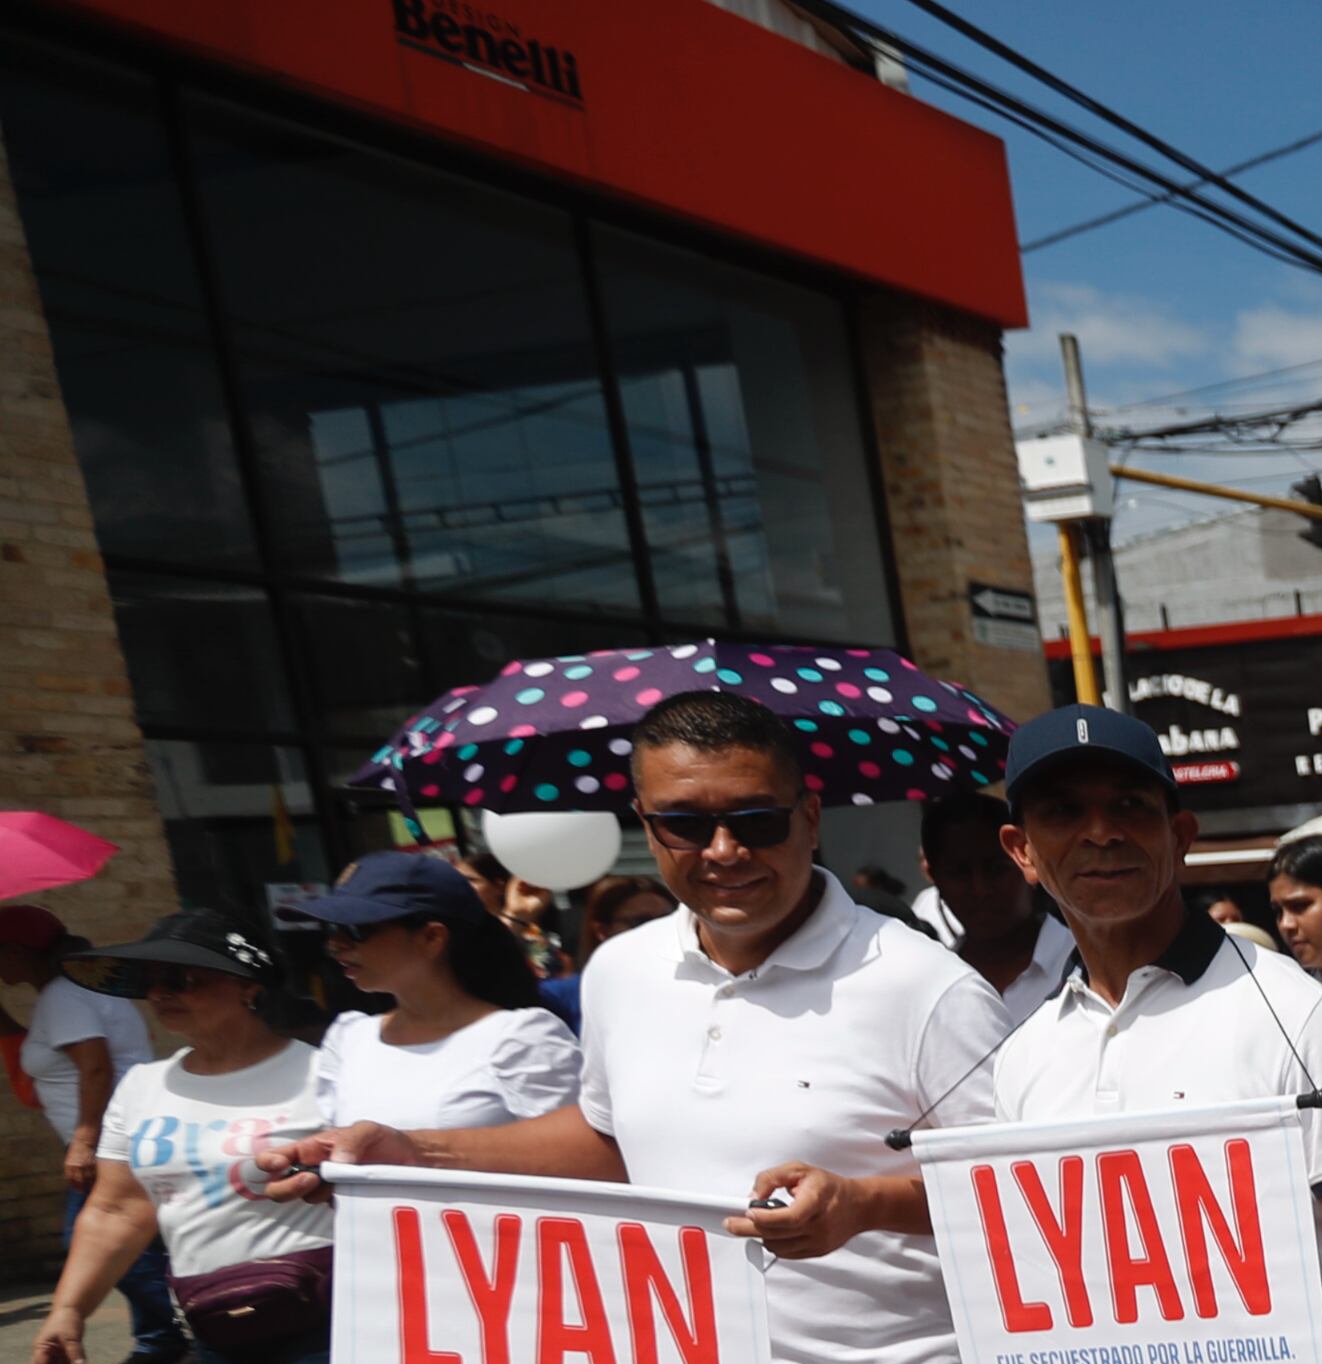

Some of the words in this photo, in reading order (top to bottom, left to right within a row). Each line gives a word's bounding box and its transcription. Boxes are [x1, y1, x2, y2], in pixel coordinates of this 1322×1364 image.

[391, 0, 581, 100] Benelli
[971, 1138, 1273, 1335] LYAN
[1183, 1341, 1204, 1364] LA
